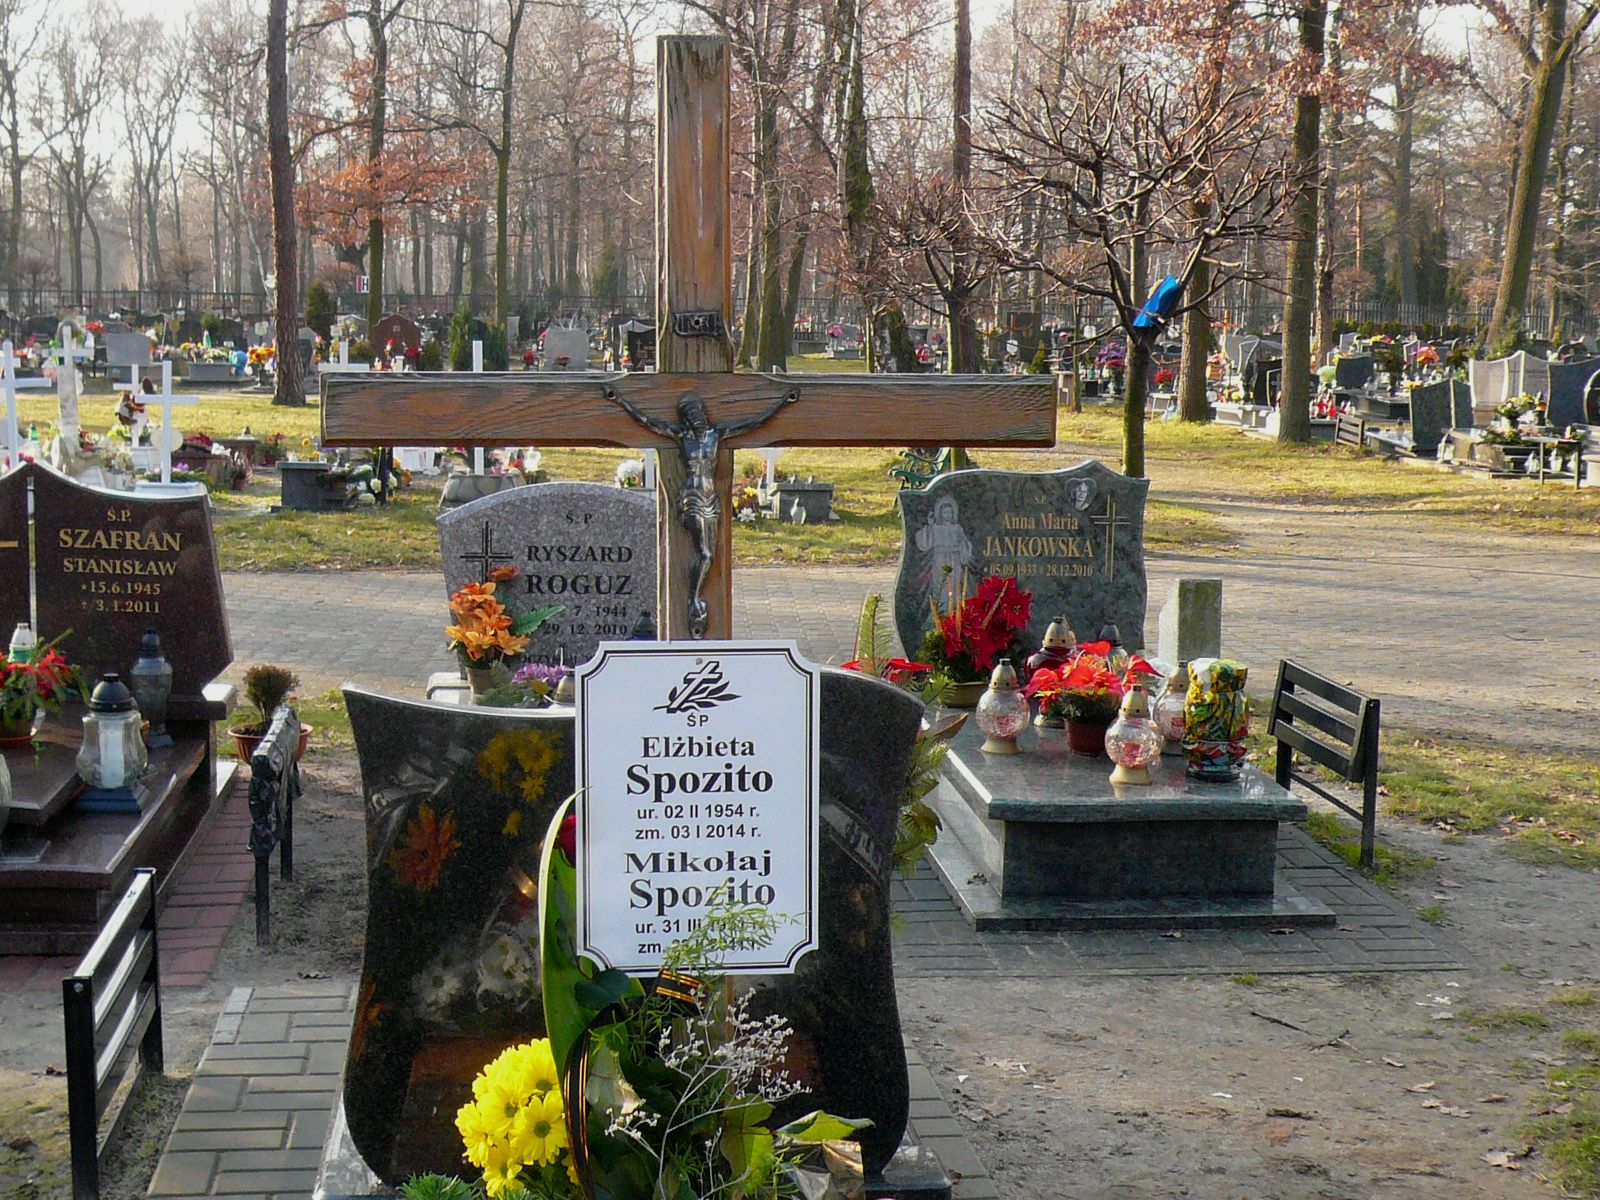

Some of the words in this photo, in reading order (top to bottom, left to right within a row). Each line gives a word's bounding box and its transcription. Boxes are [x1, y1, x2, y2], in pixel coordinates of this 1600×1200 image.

[1003, 511, 1036, 530] Anna
[1040, 512, 1079, 530] Maria
[58, 527, 182, 552] SZAFRAN
[983, 536, 1095, 558] JANKOWSKA
[526, 544, 633, 563] RYSZARD
[63, 557, 178, 576] STANISŁAW
[525, 574, 633, 595] ROGUZ
[641, 736, 756, 758] Elżbieta
[626, 763, 774, 803] Spozito
[637, 807, 659, 819] ur.
[665, 805, 684, 819] 02
[690, 804, 699, 818] II
[705, 804, 745, 818] 1954
[750, 806, 760, 818] r.
[636, 827, 665, 839] zm.
[671, 825, 691, 839] 03
[707, 824, 746, 838] 2014
[751, 826, 762, 838] r.
[625, 850, 772, 876] Mikołaj
[629, 876, 776, 917] Spozito
[636, 921, 656, 933] ur.
[663, 919, 680, 933] 31
[638, 940, 665, 953] zm.
